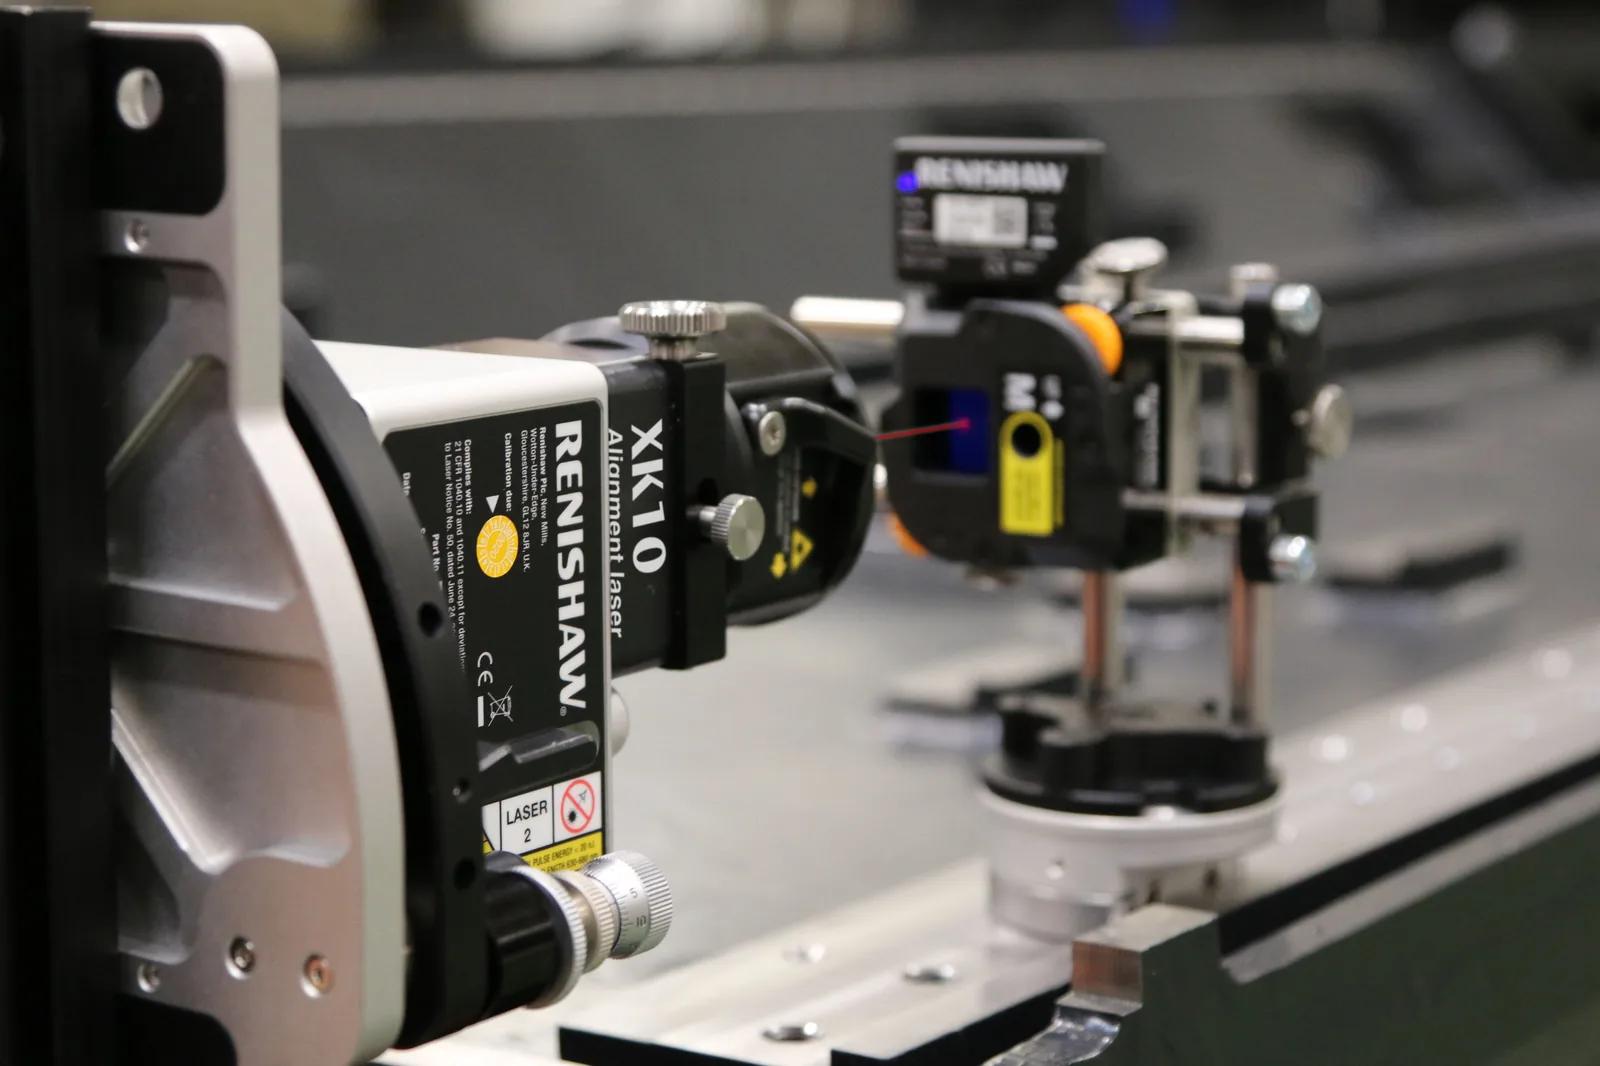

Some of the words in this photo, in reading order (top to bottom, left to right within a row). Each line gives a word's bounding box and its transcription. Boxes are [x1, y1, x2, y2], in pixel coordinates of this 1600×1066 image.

[444, 441, 453, 453] to
[454, 440, 463, 452] 21
[539, 426, 547, 475] Renishaw
[444, 454, 453, 481] Laser
[454, 455, 463, 475] CFR
[464, 439, 473, 487] Complies
[504, 432, 513, 488] Calibration
[445, 482, 454, 514] Notice
[455, 478, 464, 516] 1040.10
[465, 488, 474, 515] with:
[505, 490, 513, 512] due:
[540, 498, 548, 519] New
[631, 418, 667, 574] XK10
[456, 518, 465, 536] and
[431, 533, 441, 556] Part
[456, 539, 465, 576] 1040.11
[447, 551, 456, 579] dated
[447, 580, 456, 604] June
[457, 578, 466, 610] except
[458, 611, 466, 625] for
[610, 572, 625, 639] laser
[506, 799, 548, 825] LASER
[524, 828, 532, 843] 2
[532, 853, 550, 866] PULSE
[551, 847, 573, 861] ENERGY
